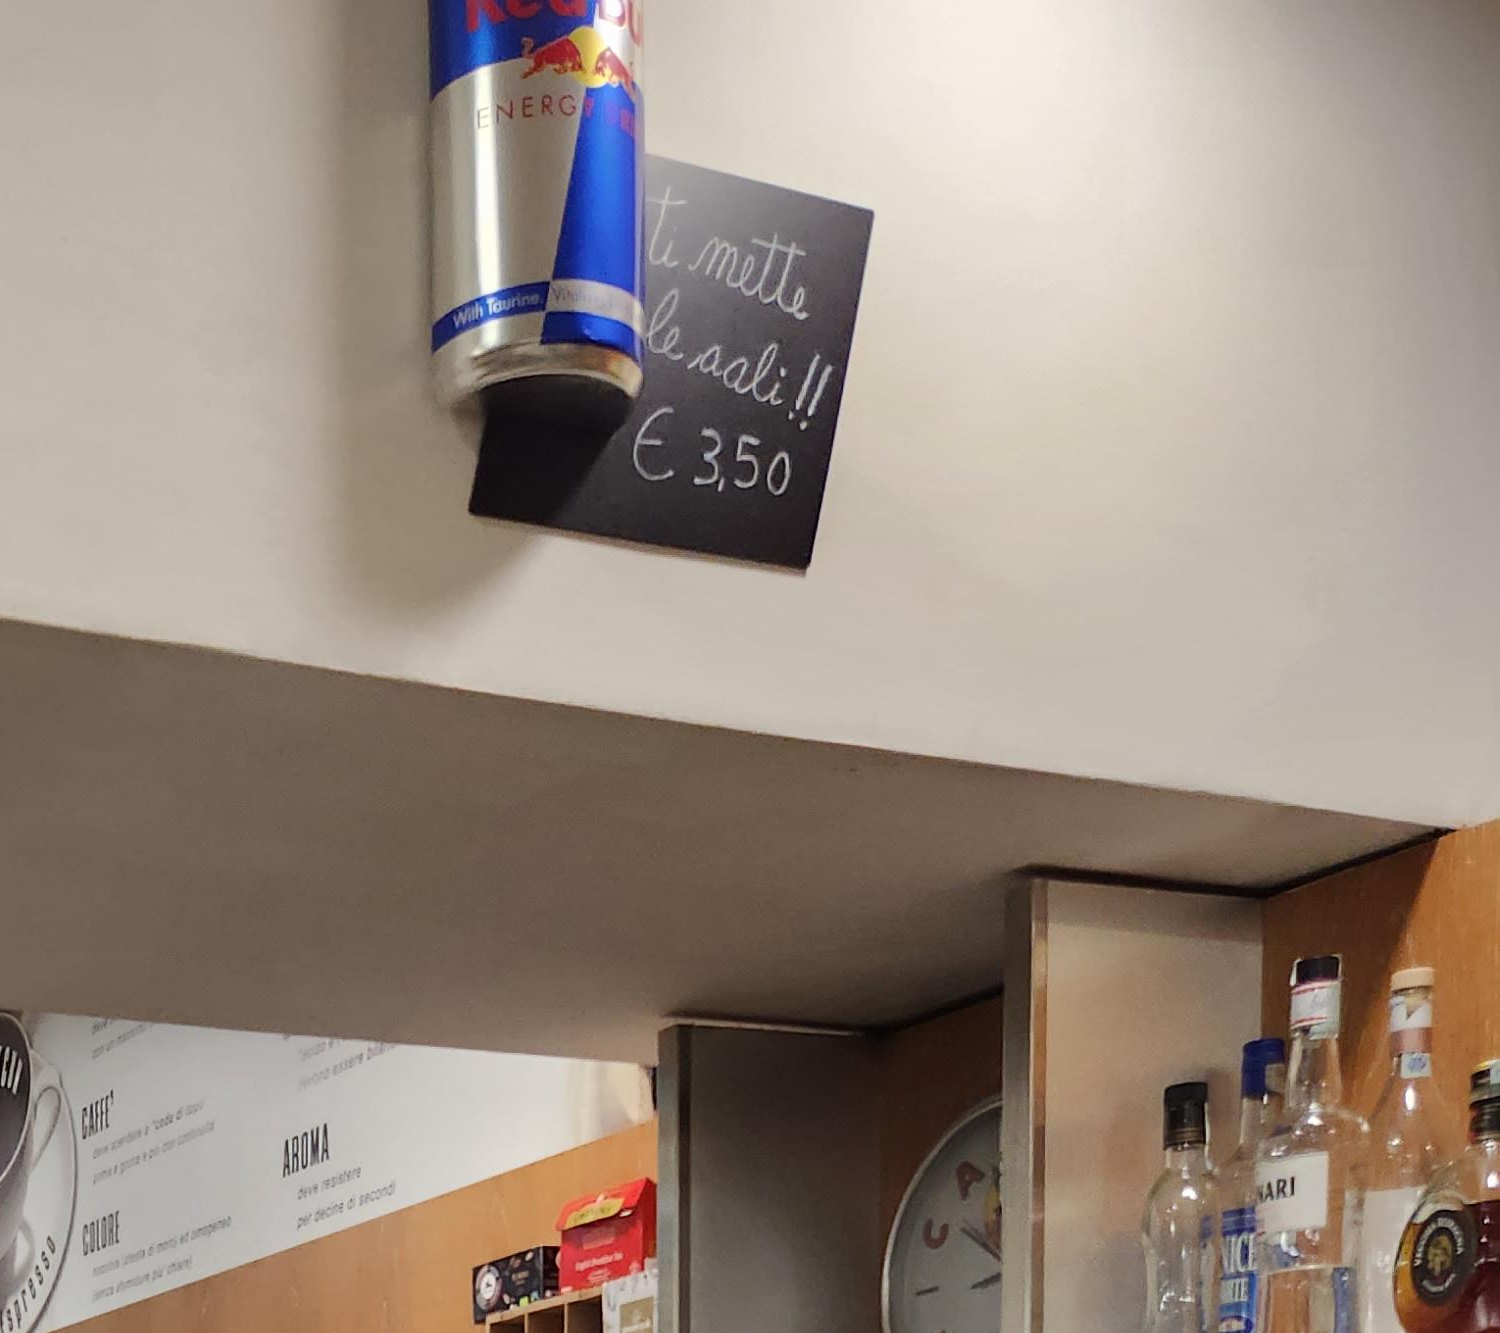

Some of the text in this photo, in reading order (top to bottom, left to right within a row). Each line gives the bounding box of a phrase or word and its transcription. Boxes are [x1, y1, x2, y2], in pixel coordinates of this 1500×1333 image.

[477, 95, 596, 129] ENERGY
[648, 186, 810, 320] ti mette
[452, 302, 484, 329] With
[646, 288, 684, 361] le
[633, 405, 791, 496] € 3,50
[281, 1121, 331, 1179] AROMA
[295, 1179, 398, 1231] per decine di secondi
[296, 1165, 363, 1201] deve resistere
[81, 1209, 121, 1258] COLORE
